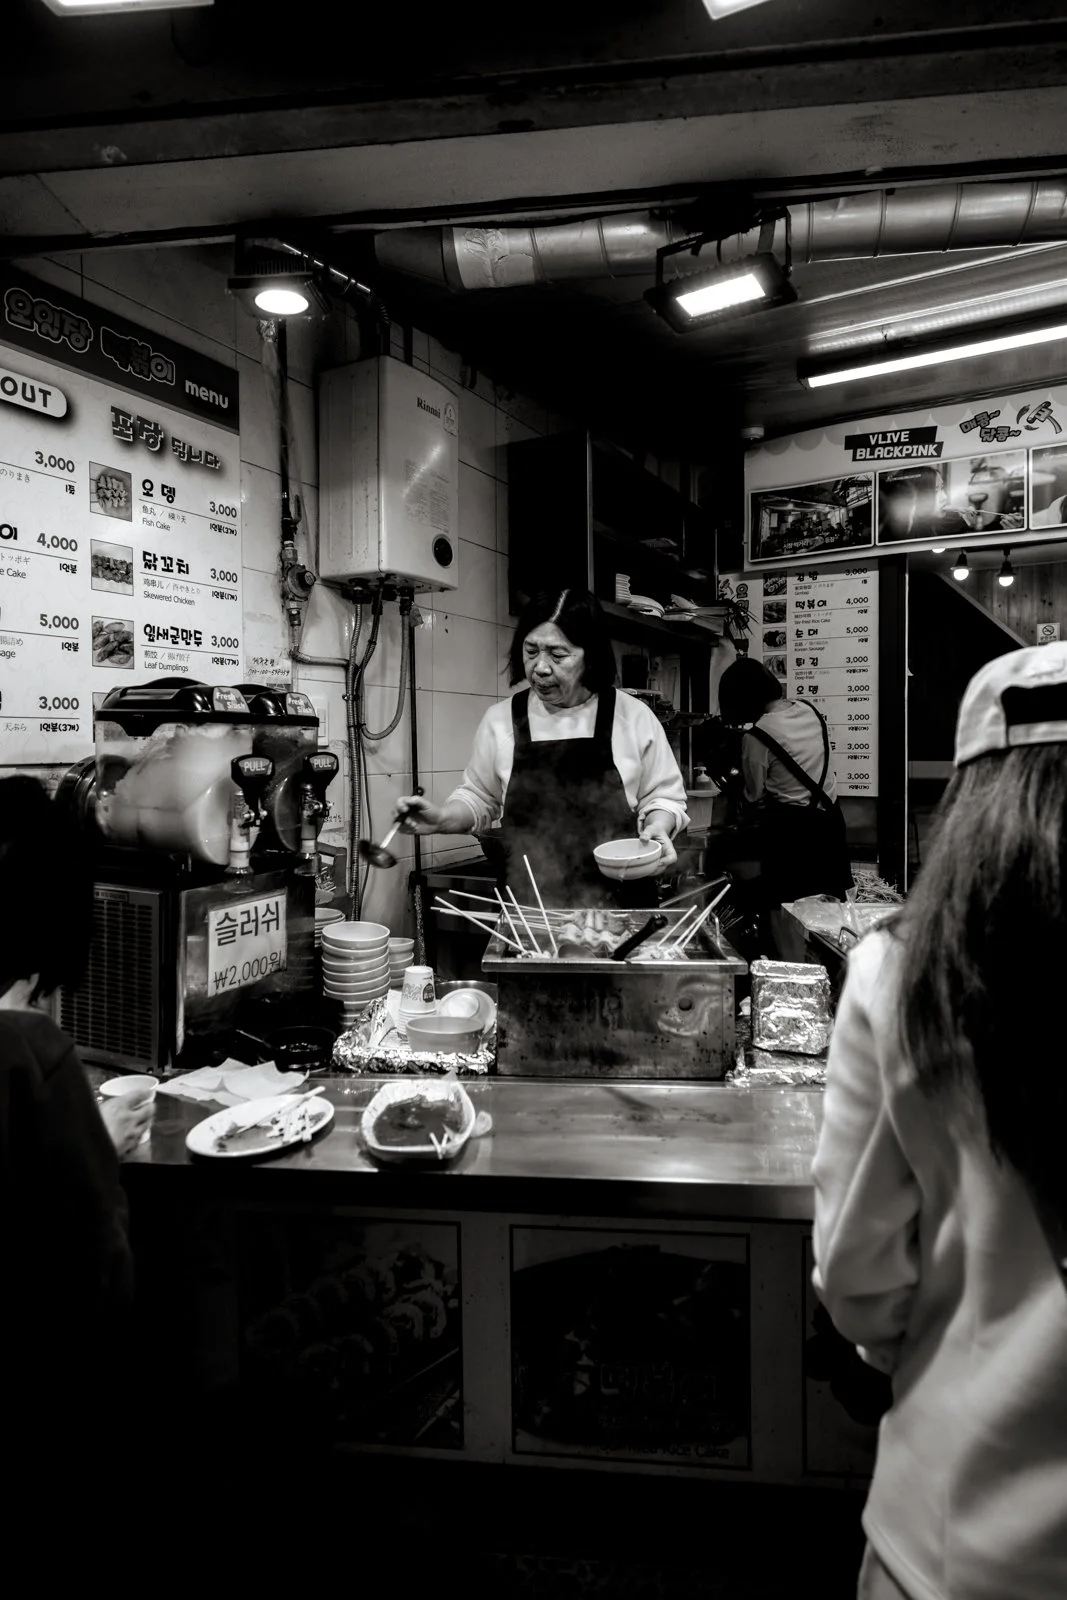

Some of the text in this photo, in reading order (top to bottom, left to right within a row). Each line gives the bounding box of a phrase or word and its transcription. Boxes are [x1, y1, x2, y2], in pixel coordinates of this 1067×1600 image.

[102, 328, 175, 384] 볶이
[0, 376, 52, 408] OUT
[184, 379, 229, 409] menu
[416, 397, 441, 419] Rinnai
[869, 431, 909, 445] VLIVE
[171, 436, 221, 469] 됩니다
[856, 443, 938, 460] BLACKPINK
[35, 451, 75, 473] 3,000
[210, 501, 237, 518] 3,000
[142, 518, 171, 531] Fish Cake
[37, 533, 78, 552] 4,000
[142, 550, 189, 575] 닭꼬치
[6, 568, 26, 579] Cake
[211, 568, 238, 583] 3,000
[845, 567, 868, 577] 3,000
[143, 591, 196, 606] Skewered Chicken
[846, 597, 869, 606] 4,000
[39, 613, 79, 630] 5,000
[143, 623, 203, 647] 잎새군만두
[846, 626, 868, 634] 5,000
[211, 635, 239, 649] 3,000
[144, 661, 189, 673] Leaf Dumplings
[39, 696, 79, 711] 3,000
[216, 692, 235, 702] Fresh
[4, 723, 27, 731] 天ぷら
[244, 761, 266, 772] PULL
[314, 759, 332, 769] PULL
[215, 901, 281, 947] 슬러쉬
